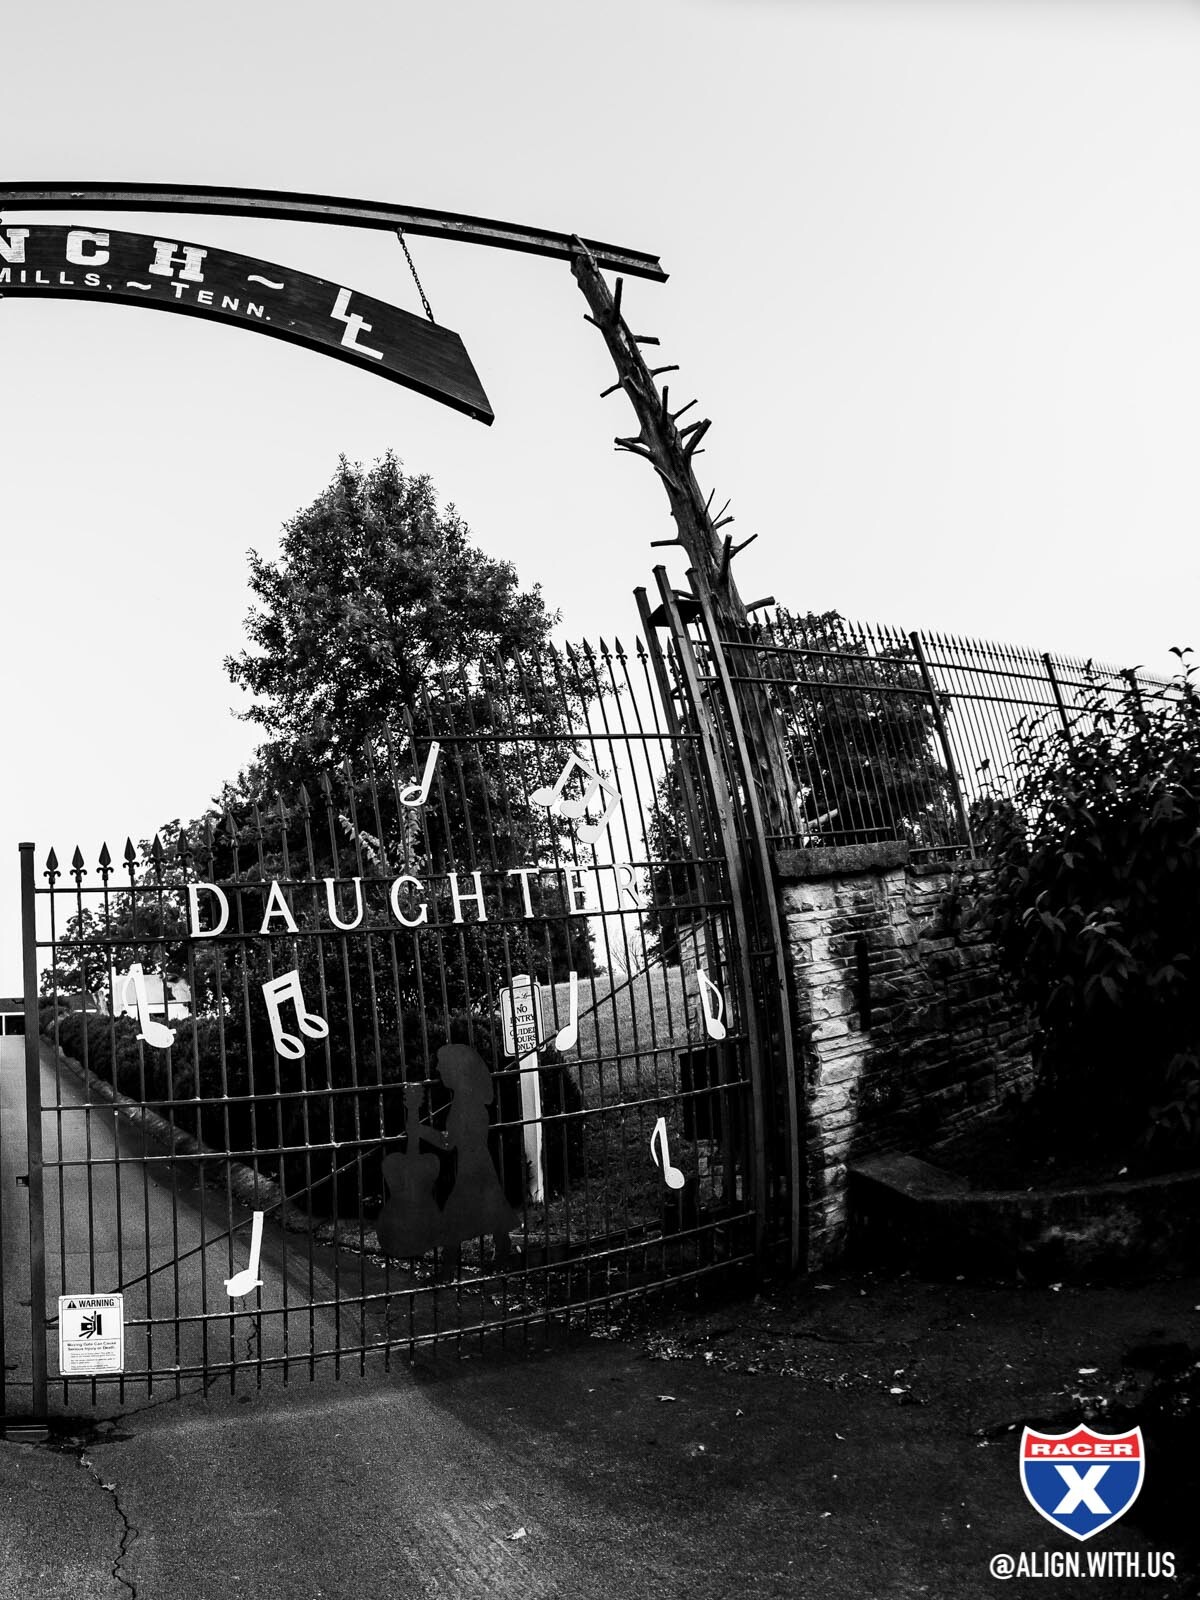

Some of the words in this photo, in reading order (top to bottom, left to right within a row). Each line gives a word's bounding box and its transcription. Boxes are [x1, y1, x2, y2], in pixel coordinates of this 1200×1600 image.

[170, 281, 271, 321] TENN.
[188, 863, 648, 937] DAUGHTER
[516, 1005, 528, 1014] NO
[512, 1034, 536, 1043] OURS
[79, 1299, 114, 1307] WARNING
